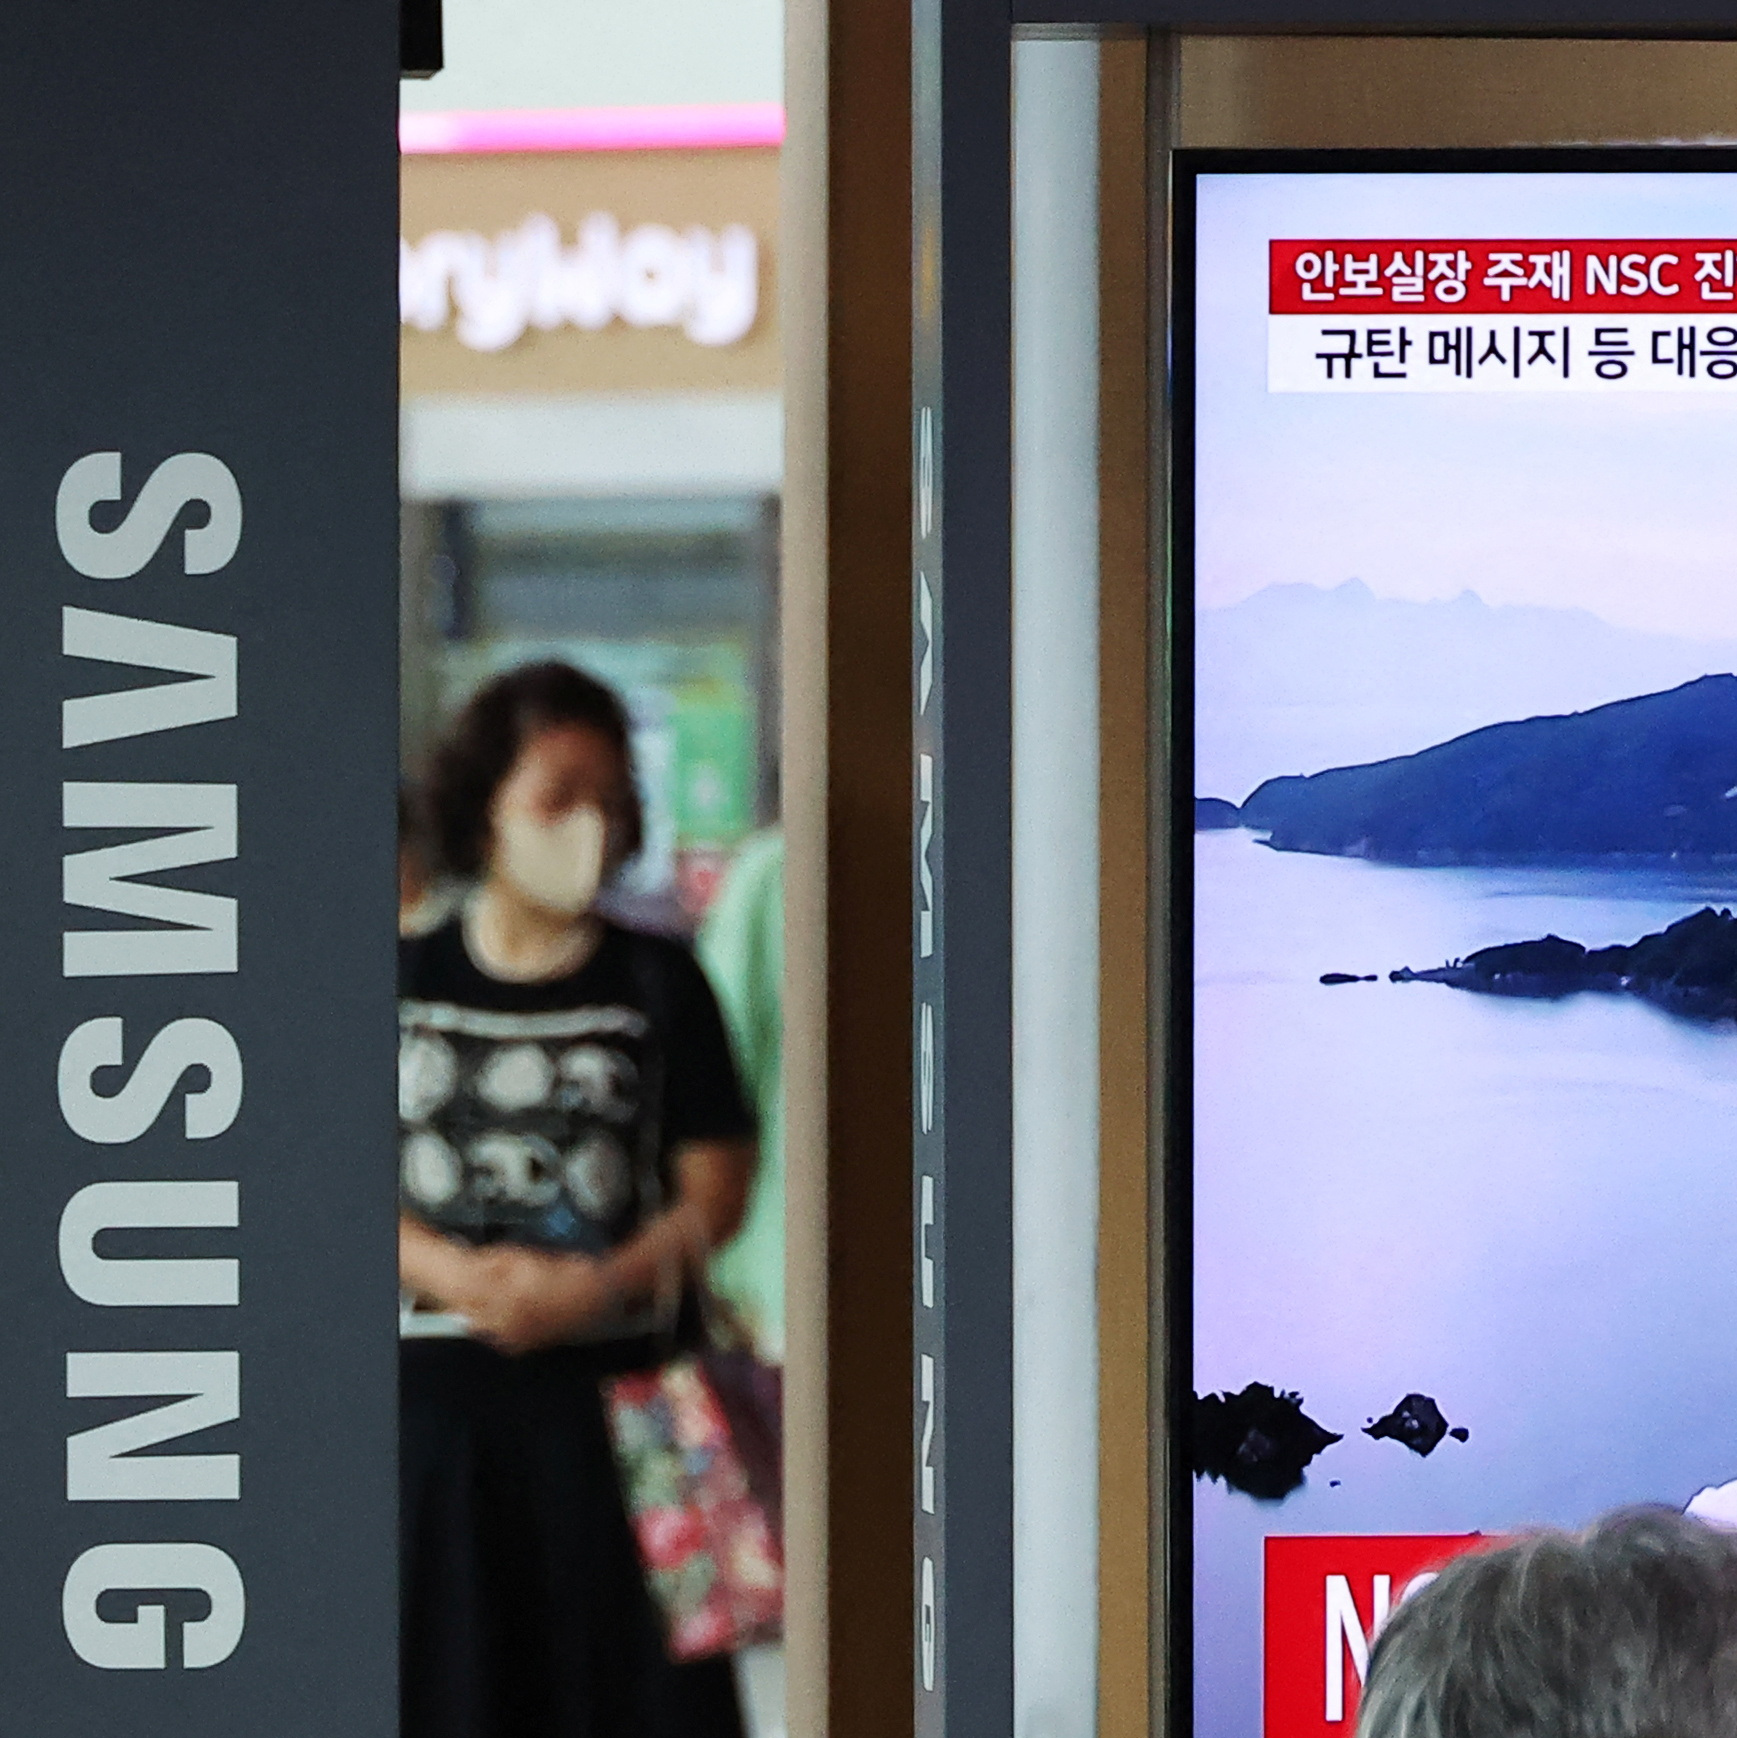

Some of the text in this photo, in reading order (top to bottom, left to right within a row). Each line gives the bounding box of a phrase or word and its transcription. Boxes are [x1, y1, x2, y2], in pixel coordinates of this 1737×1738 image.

[1296, 251, 1471, 302] 안보실장
[1484, 250, 1570, 301] 주재
[1587, 254, 1679, 295] NSC
[1316, 327, 1412, 378] 규탄
[1429, 327, 1569, 378] 메시지
[1588, 328, 1635, 379] 등
[56, 452, 245, 1669] SAMSUNG
[917, 405, 935, 1692] SAMSUNG
